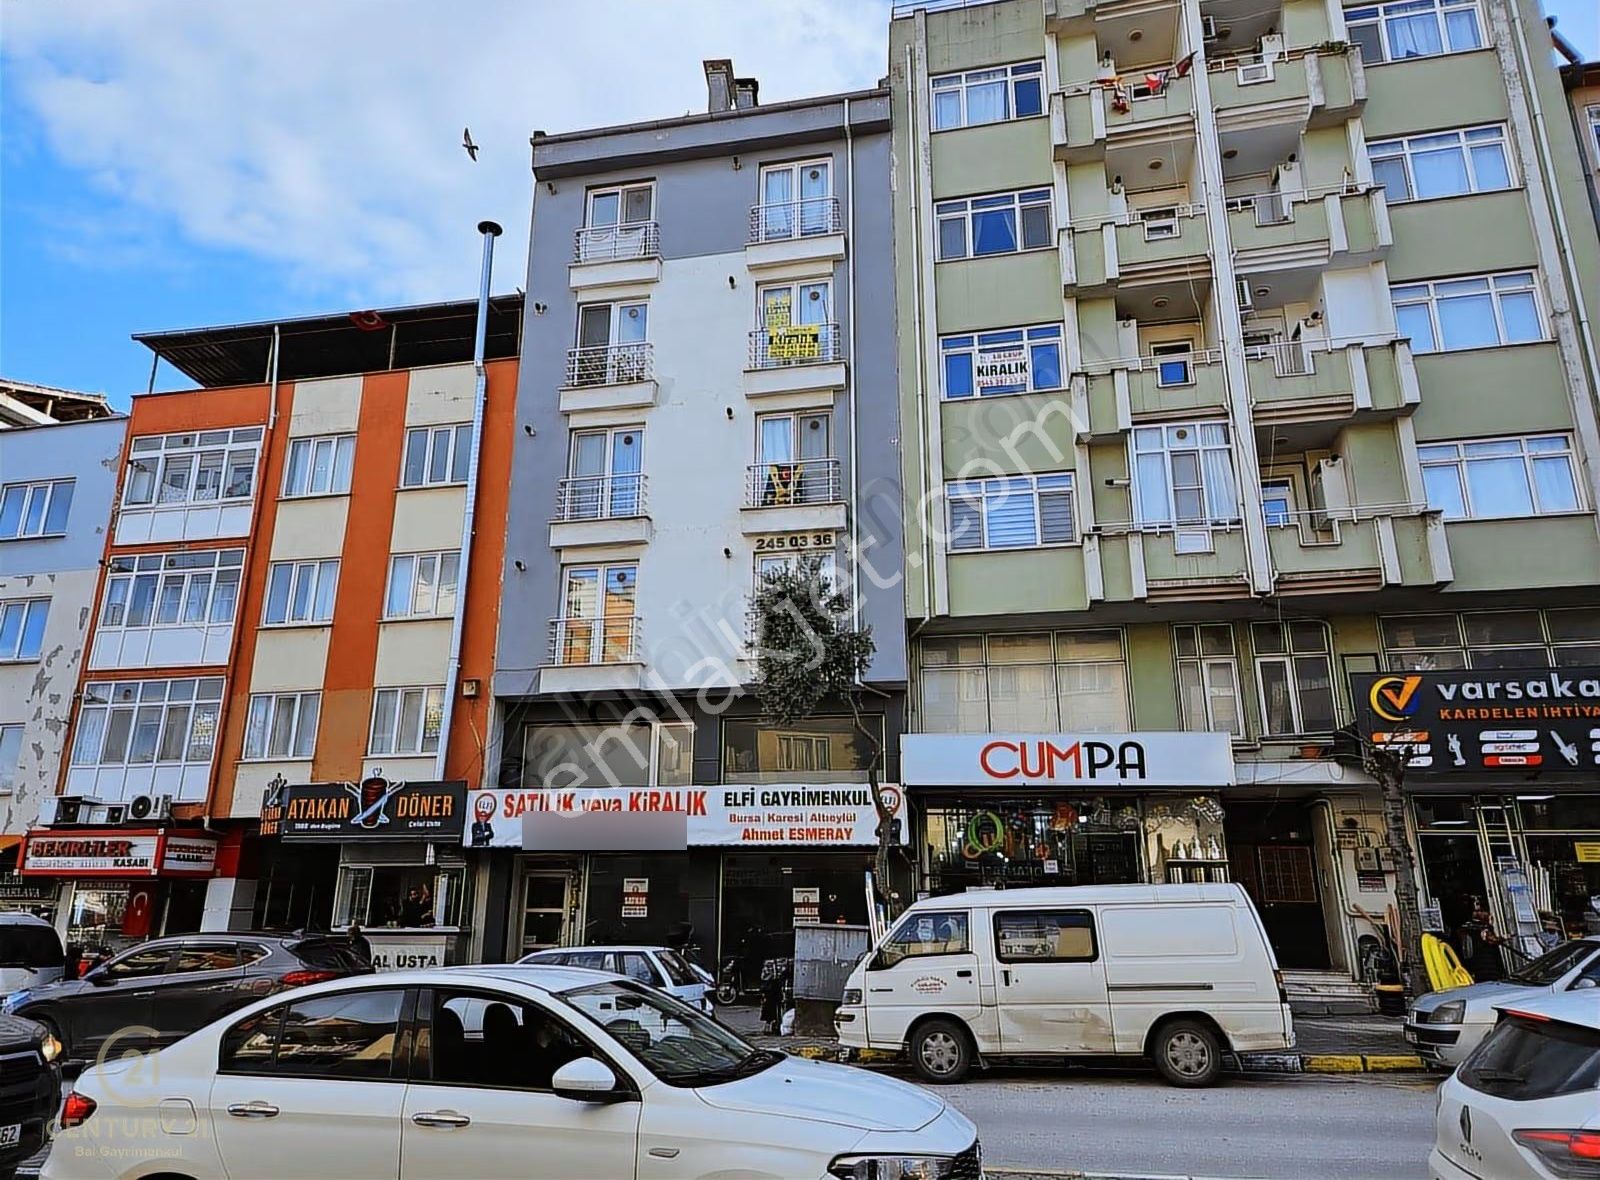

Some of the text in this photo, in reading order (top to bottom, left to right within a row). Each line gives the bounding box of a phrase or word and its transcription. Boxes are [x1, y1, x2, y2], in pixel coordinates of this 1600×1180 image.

[756, 537, 785, 550] 245
[813, 534, 832, 546] 36
[1440, 708, 1539, 720] KARDELEN
[980, 741, 1146, 780] CUMPA
[724, 786, 872, 807] ELFİ GAYRİMENKUL
[287, 792, 453, 820] ATAKAN DÖNER
[729, 813, 761, 824] Bursa
[767, 813, 804, 824] Karesi
[742, 828, 853, 841] Ahmet ESMERAY
[396, 954, 438, 968] USTA
